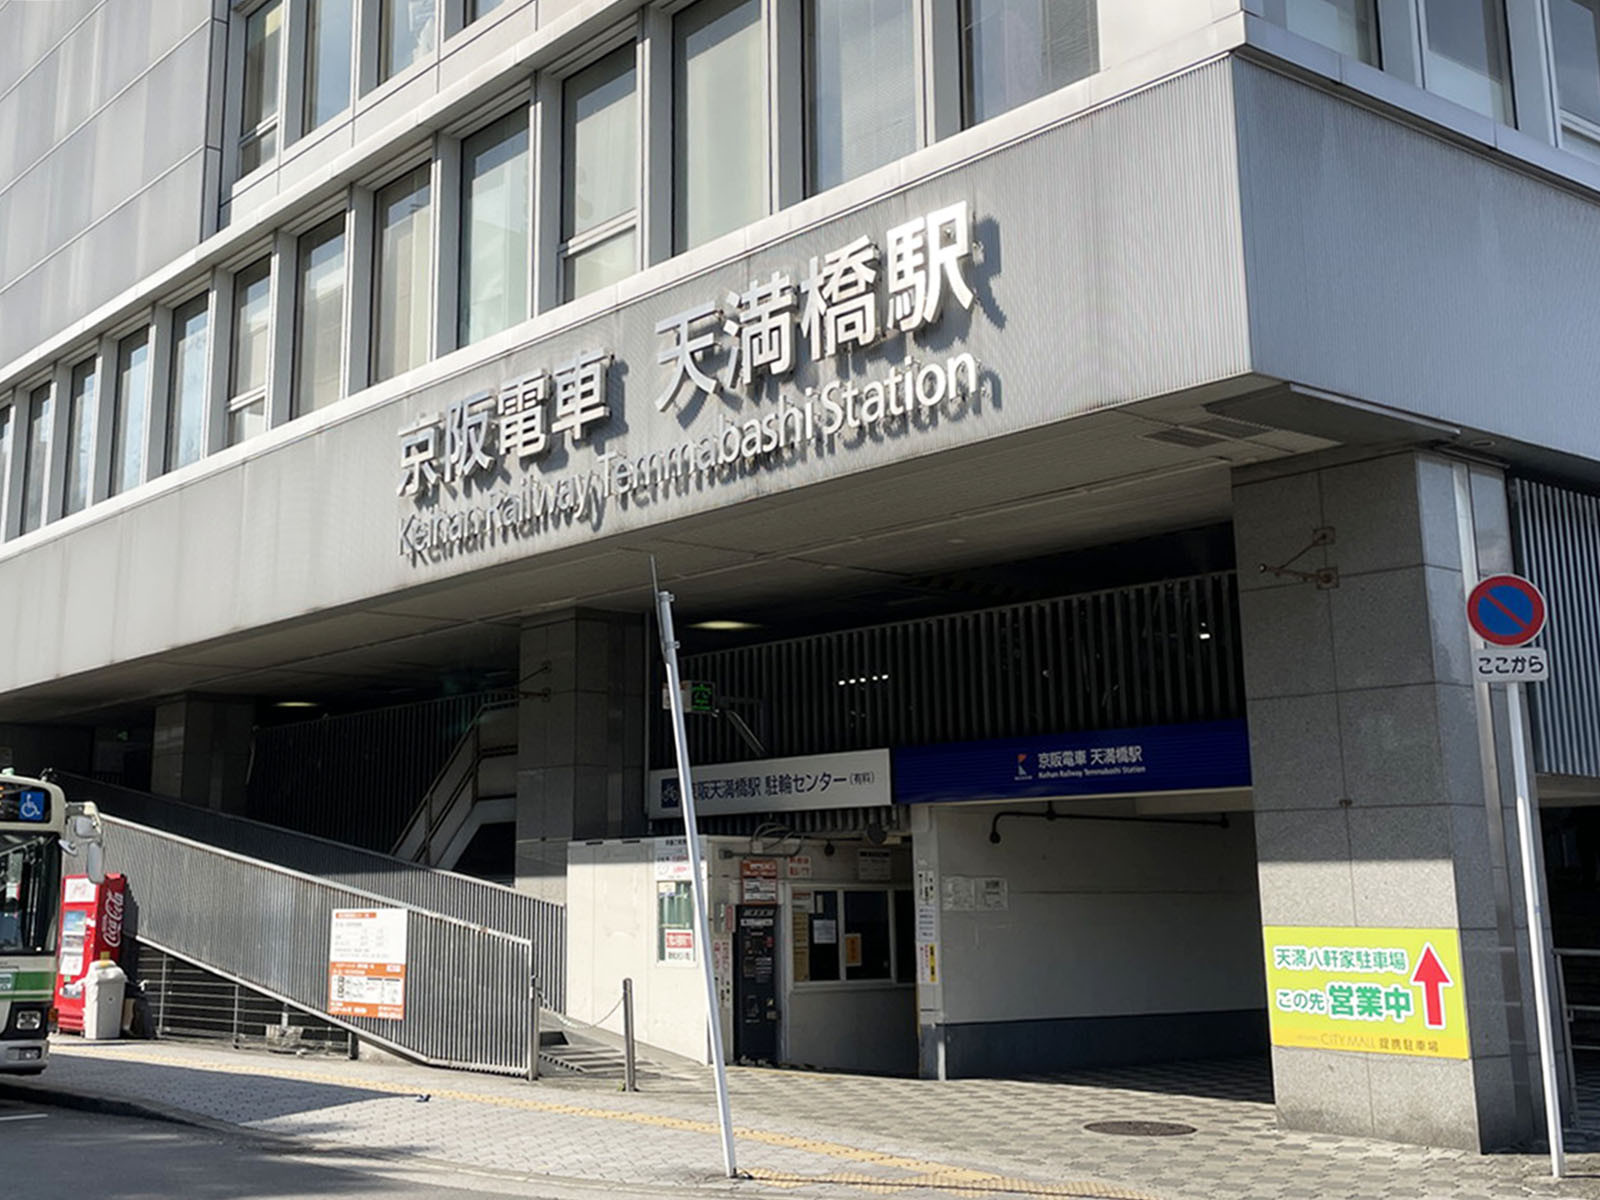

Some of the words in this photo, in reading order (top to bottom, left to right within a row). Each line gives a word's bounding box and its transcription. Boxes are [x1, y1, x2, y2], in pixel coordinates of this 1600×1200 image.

[397, 348, 612, 497] 京阪電車
[654, 201, 974, 413] 天満橋駅
[398, 504, 482, 556] Keihan
[597, 388, 814, 497] Temmabashi
[821, 352, 977, 434] Station
[1478, 655, 1544, 674] ここから
[1038, 750, 1087, 768] 京阪電車
[1090, 745, 1143, 766] 天満橋駅
[1275, 947, 1406, 970] 天満八軒家駐車場
